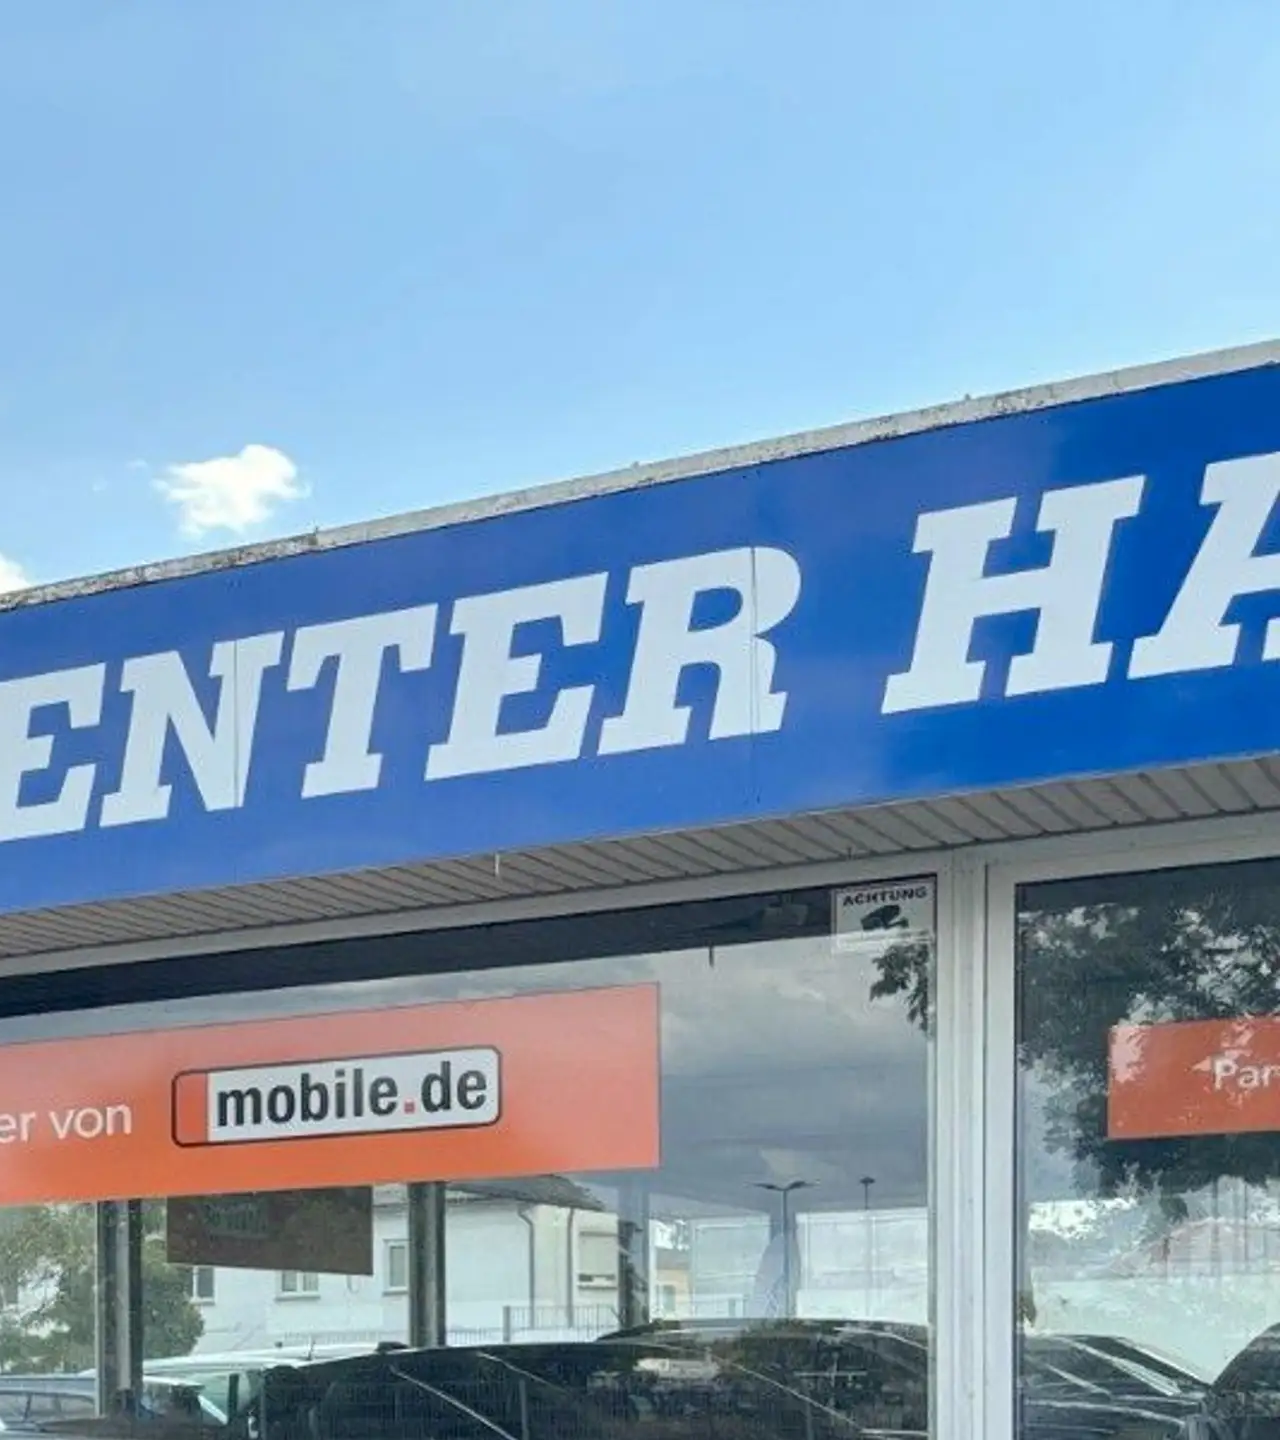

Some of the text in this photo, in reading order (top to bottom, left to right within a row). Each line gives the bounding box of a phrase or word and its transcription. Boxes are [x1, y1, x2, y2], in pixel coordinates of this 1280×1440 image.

[842, 885, 928, 907] ACHTUNG
[48, 1102, 133, 1140] von
[216, 1060, 488, 1127] mobile.de
